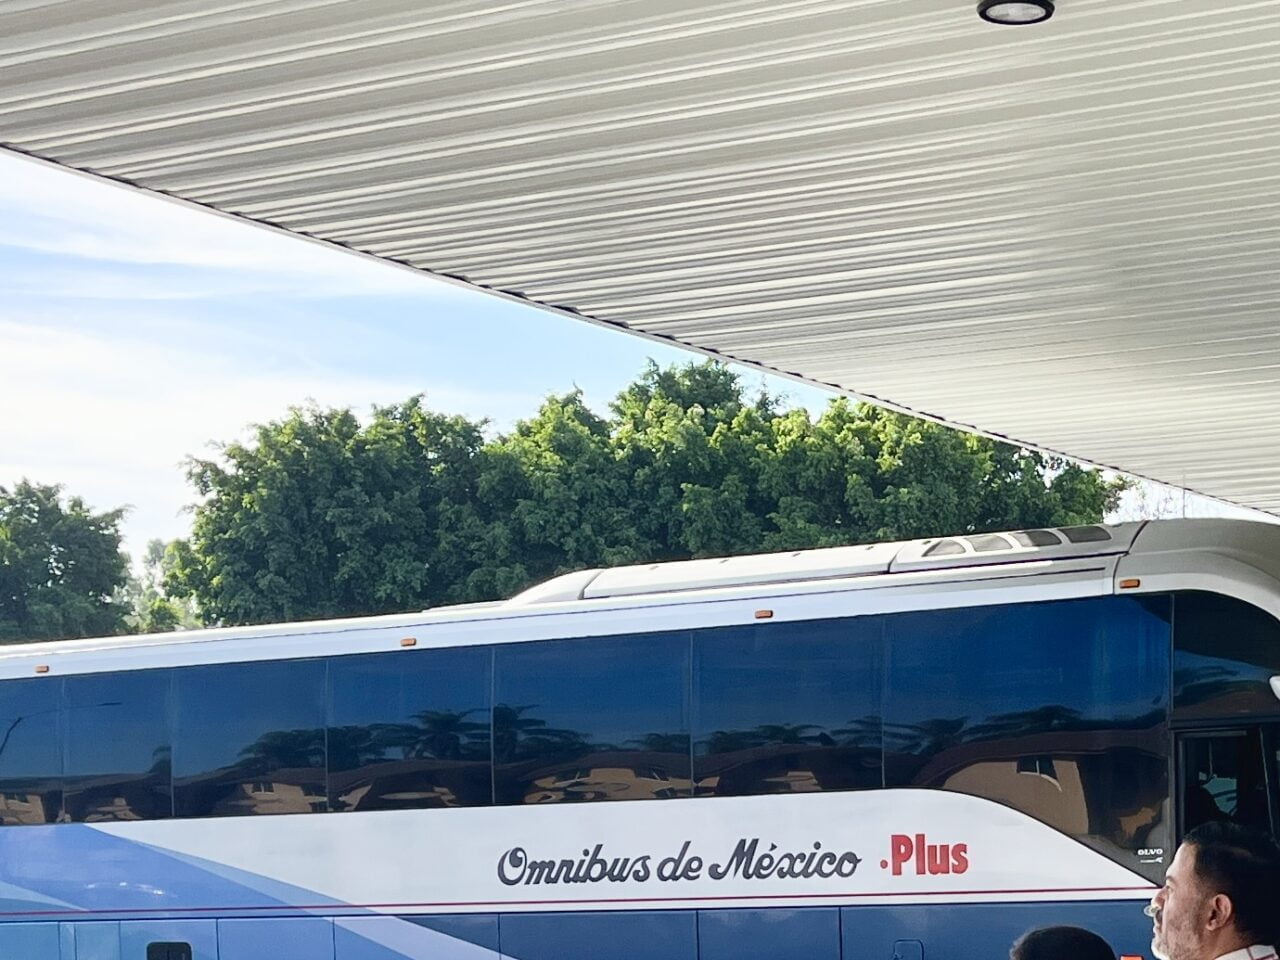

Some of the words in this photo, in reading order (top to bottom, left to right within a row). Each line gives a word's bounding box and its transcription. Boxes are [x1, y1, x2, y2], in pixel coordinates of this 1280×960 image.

[498, 844, 650, 886] Omnibus
[657, 841, 704, 881] de
[709, 838, 863, 880] México
